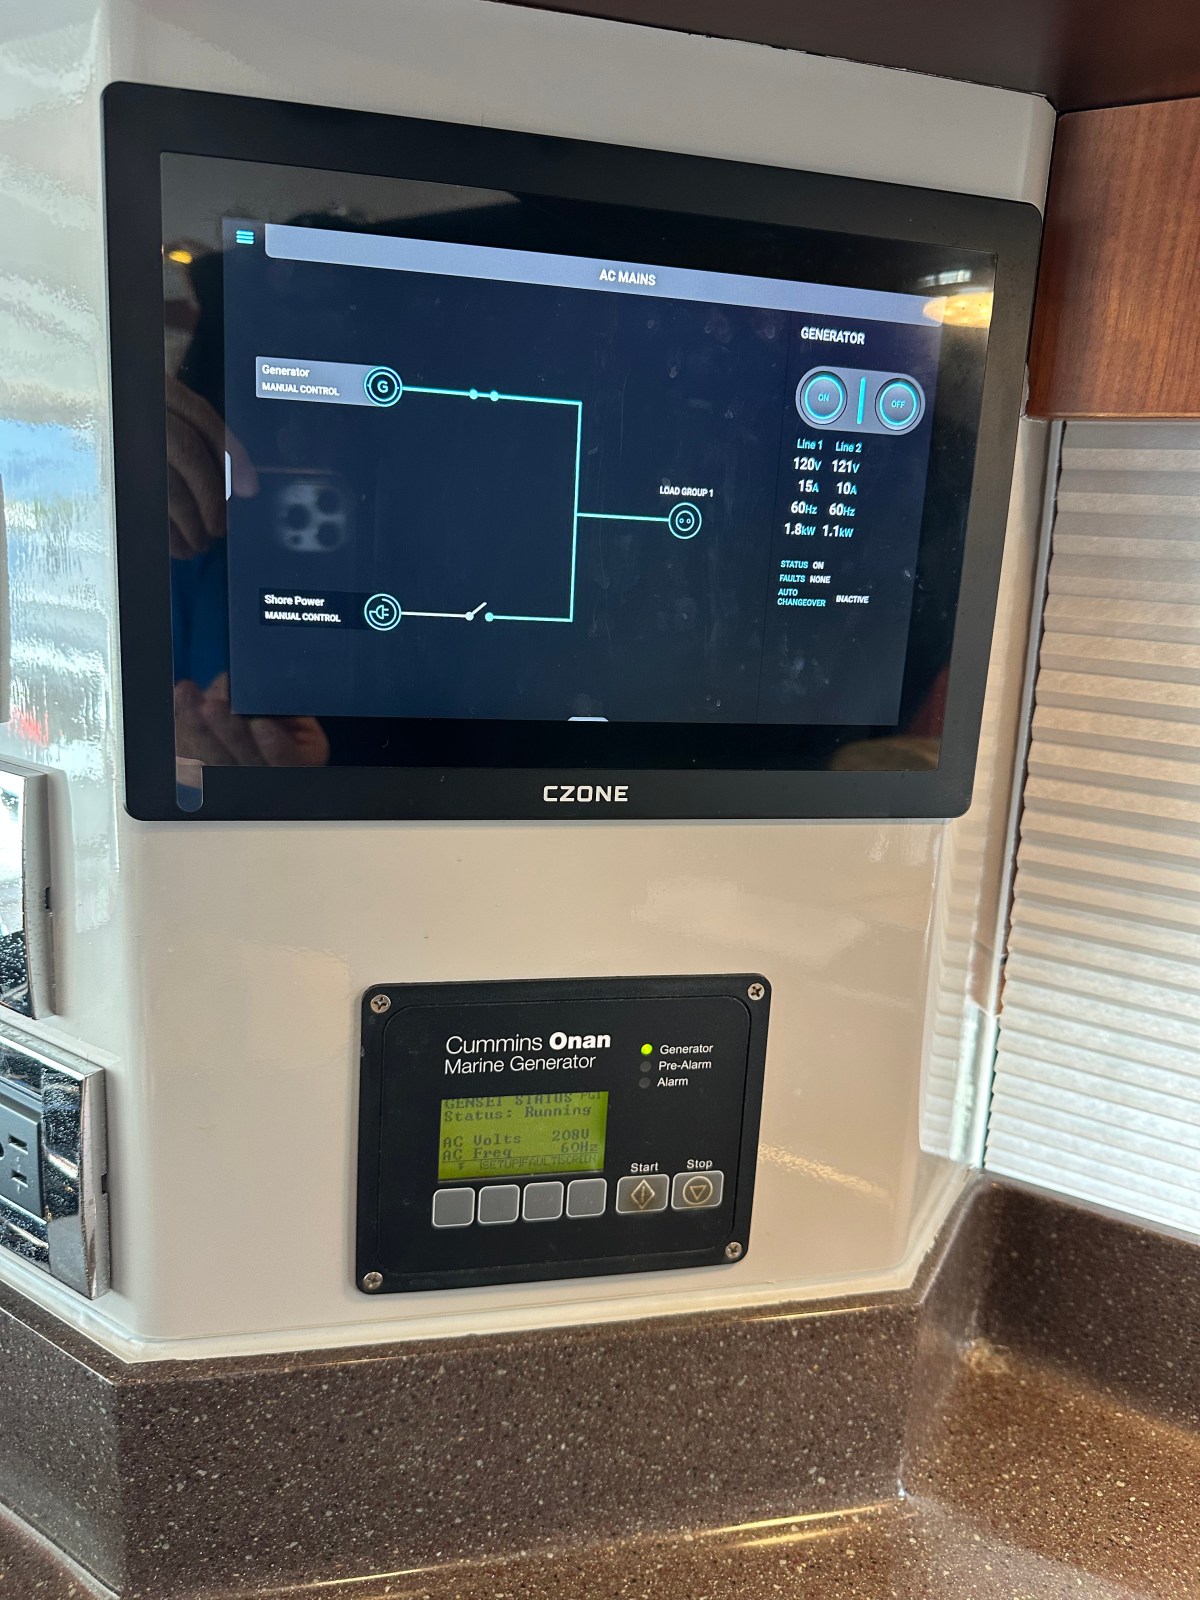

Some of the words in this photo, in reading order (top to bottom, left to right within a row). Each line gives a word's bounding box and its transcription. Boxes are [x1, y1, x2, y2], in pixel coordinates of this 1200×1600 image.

[599, 268, 616, 281] AC
[617, 271, 656, 286] MAINS
[800, 326, 865, 345] GENERATOR
[261, 364, 310, 378] Generator
[261, 382, 299, 393] MANUAL
[299, 385, 340, 396] CONTROL
[377, 380, 389, 393] G
[817, 393, 830, 402] ON
[891, 400, 905, 408] OFF
[796, 438, 816, 450] Line
[818, 440, 823, 450] 1
[835, 441, 855, 452] Line
[855, 443, 862, 453] 2
[793, 456, 822, 471] 120V
[831, 459, 860, 474] 121V
[660, 485, 680, 495] LOAD
[681, 487, 708, 497] GROUP
[708, 488, 714, 498] 1
[798, 479, 819, 493] 15A
[836, 481, 857, 495] 10A
[790, 501, 818, 515] 60Hz
[828, 502, 856, 517] 60Hz
[784, 522, 816, 536] 1.8kW
[822, 524, 854, 538] 1.1kW
[780, 560, 809, 569] STATUS
[812, 561, 824, 570] ON
[779, 574, 806, 583] FAULTS
[809, 575, 831, 584] NONE
[777, 588, 799, 597] AUTO
[836, 594, 870, 604] INACTIVE
[264, 594, 293, 605] Shore
[294, 596, 325, 607] Power
[777, 598, 826, 607] CHANGEOVER
[264, 611, 301, 621] MANUAL
[301, 613, 342, 623] CONTROL
[543, 785, 629, 802] CZONE
[446, 1034, 543, 1055] Cummins
[549, 1031, 611, 1051] Onan
[660, 1044, 714, 1055] Generator
[444, 1057, 505, 1075] Marine
[509, 1054, 597, 1072] Generator
[658, 1060, 712, 1071] Pre-Alarm
[656, 1077, 689, 1087] Alarm
[444, 1110, 512, 1122] Status:
[525, 1104, 592, 1118] Running
[443, 1136, 463, 1148] AC
[473, 1131, 521, 1145] Volts
[552, 1128, 590, 1142] 208V
[442, 1148, 463, 1161] AC
[473, 1147, 512, 1159] Freq
[561, 1141, 598, 1154] 60Hz
[630, 1162, 659, 1173] Start
[687, 1159, 713, 1170] Stop
